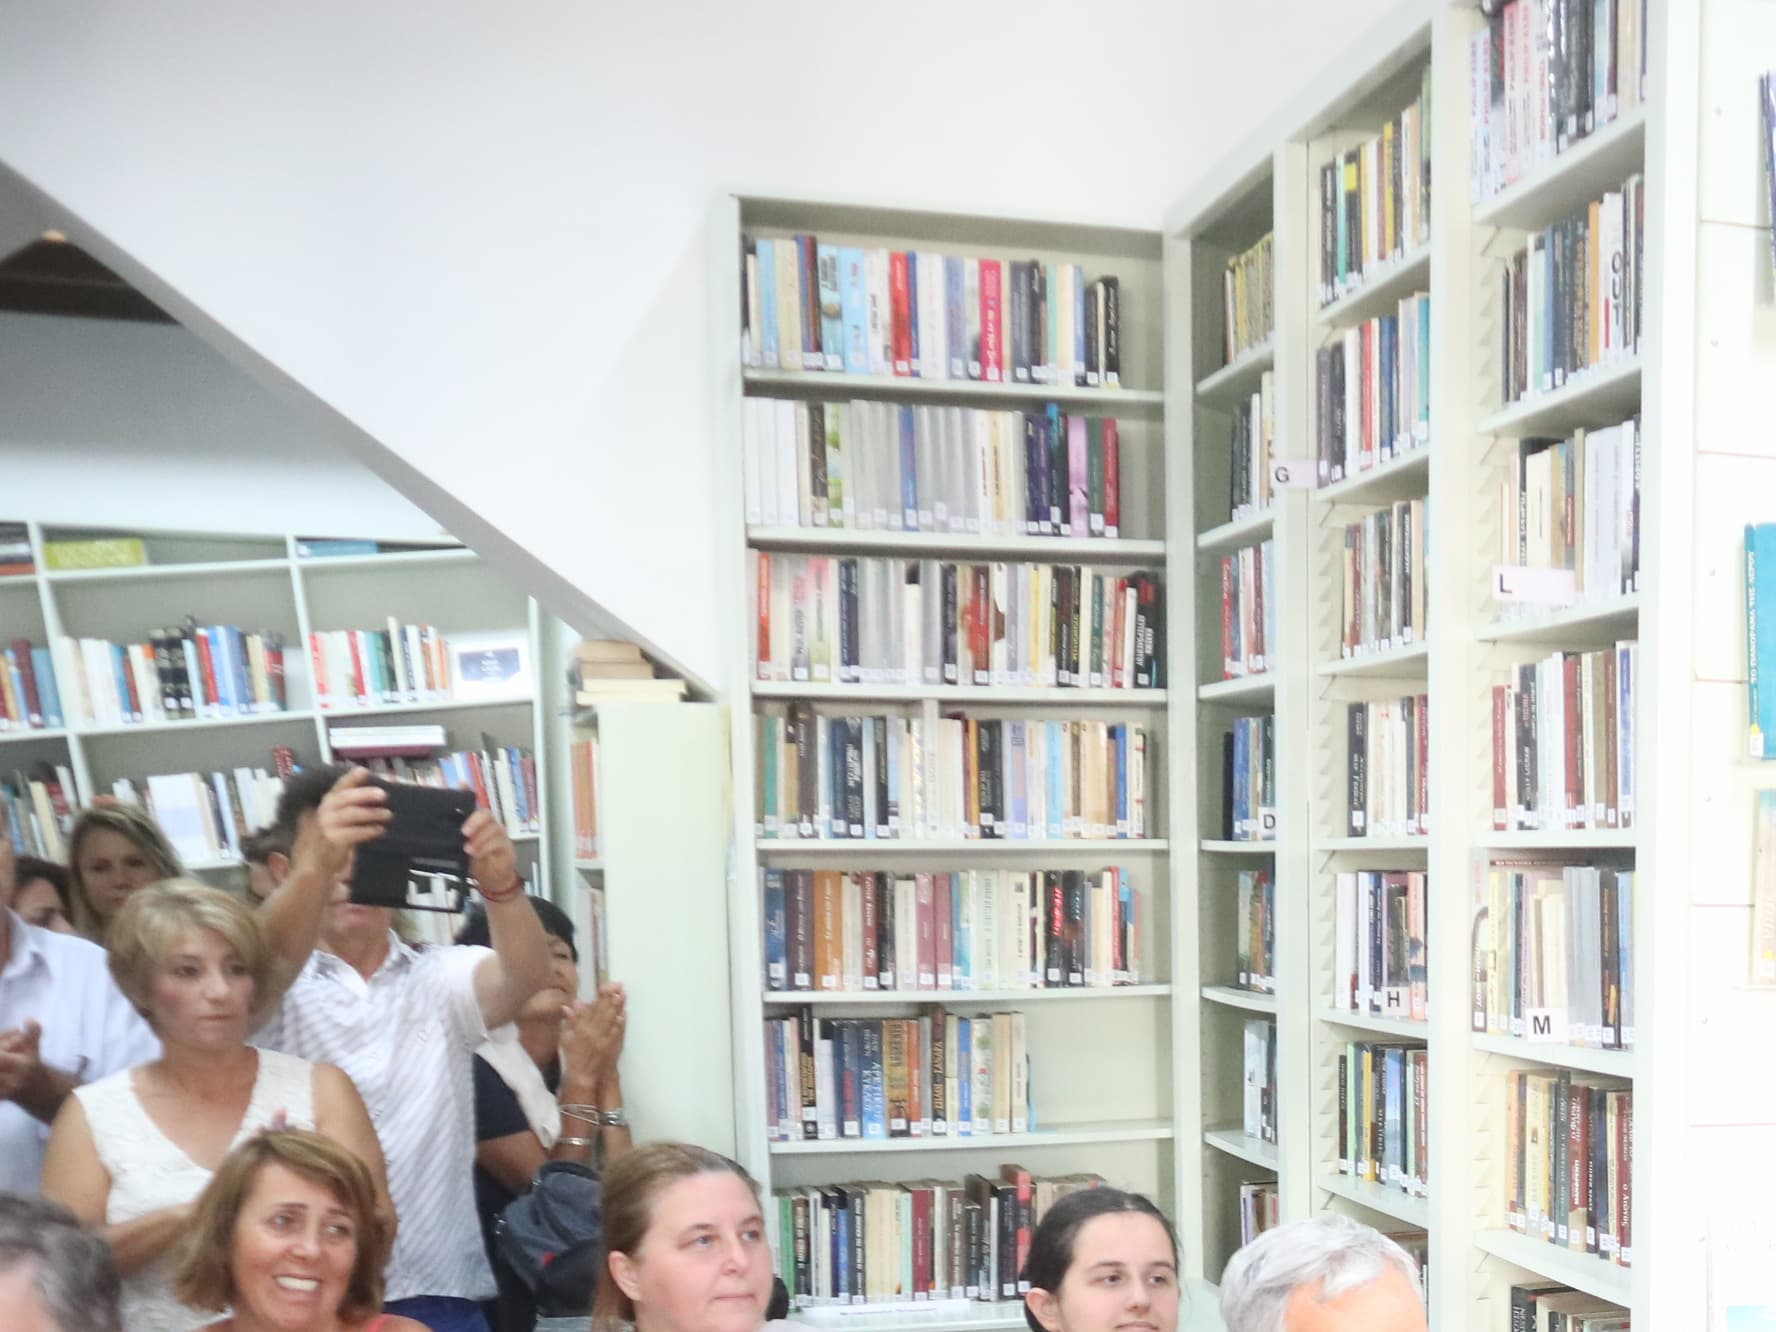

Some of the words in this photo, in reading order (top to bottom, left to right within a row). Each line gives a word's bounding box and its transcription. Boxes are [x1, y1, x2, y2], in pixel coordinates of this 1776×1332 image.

[1275, 467, 1290, 483] G
[1499, 573, 1512, 595] L
[1263, 814, 1276, 831] D
[1387, 990, 1401, 1009] H
[1532, 1015, 1552, 1036] M
